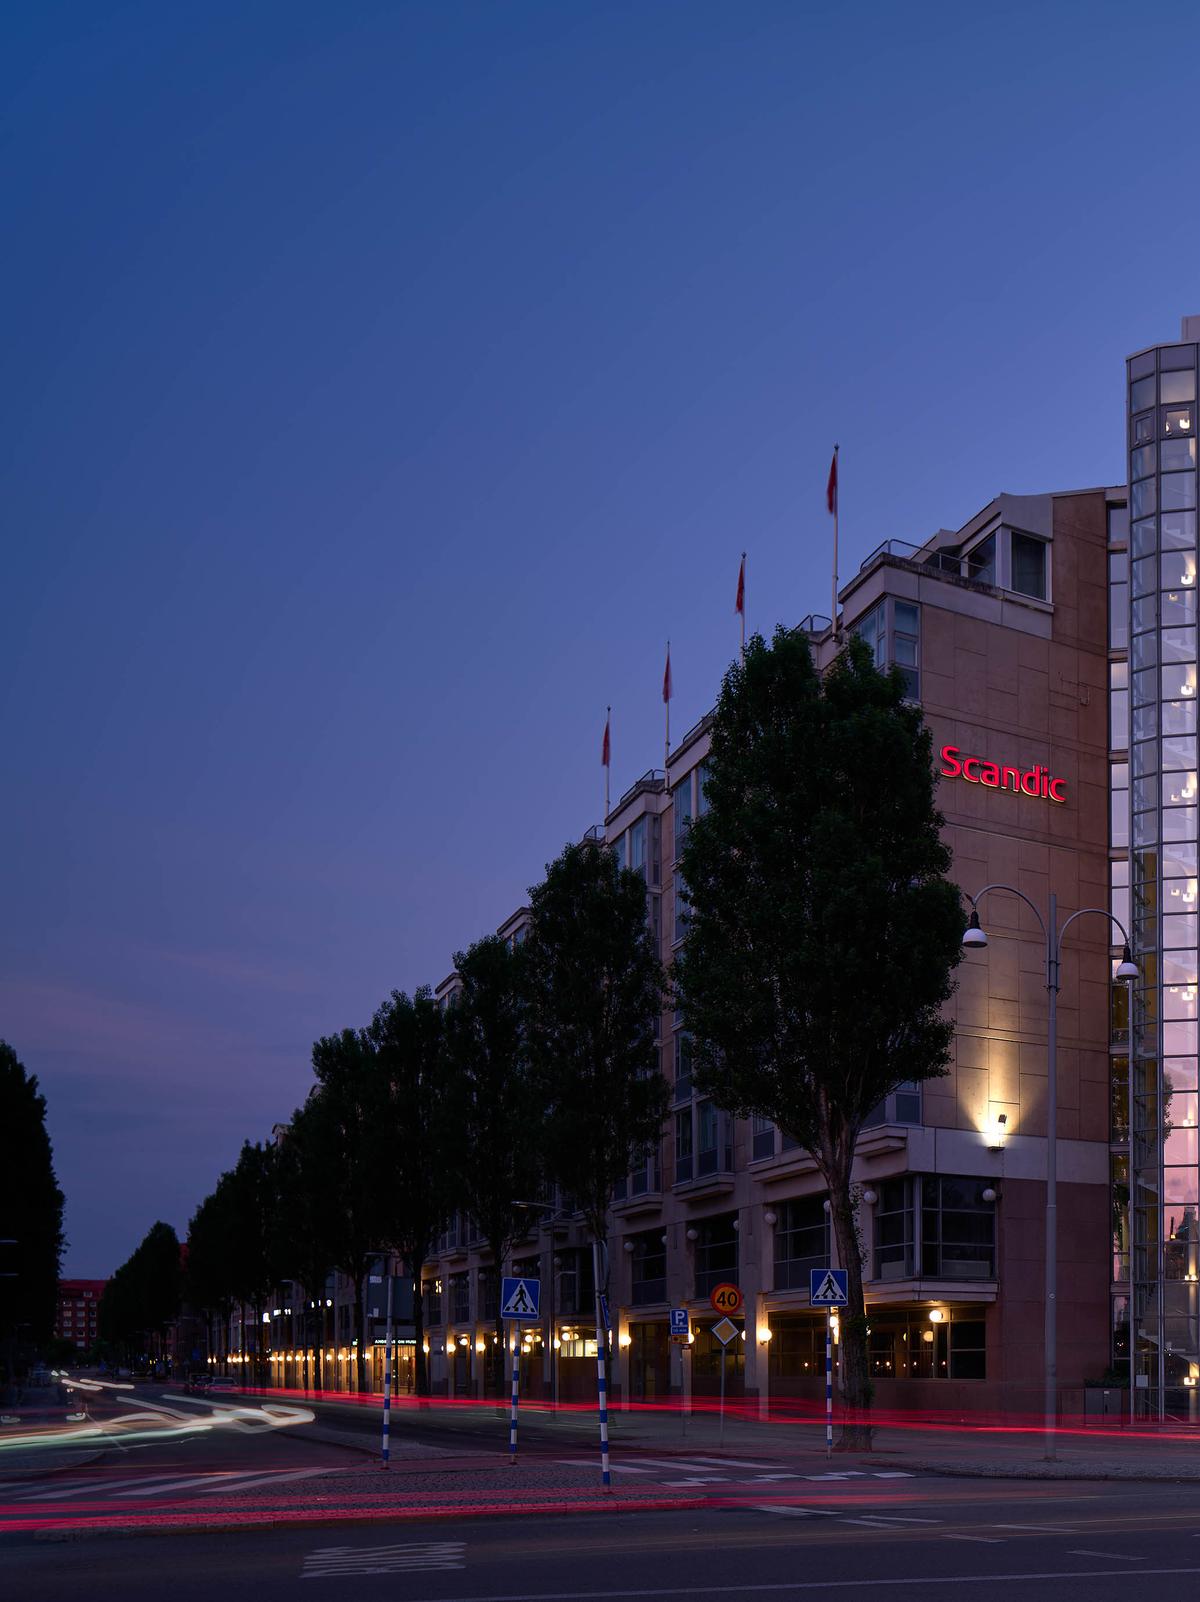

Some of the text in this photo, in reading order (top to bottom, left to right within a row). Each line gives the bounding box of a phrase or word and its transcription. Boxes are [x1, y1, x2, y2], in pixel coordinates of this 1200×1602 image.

[940, 745, 1067, 802] Scandic
[716, 1291, 738, 1307] 40
[675, 1310, 685, 1325] P
